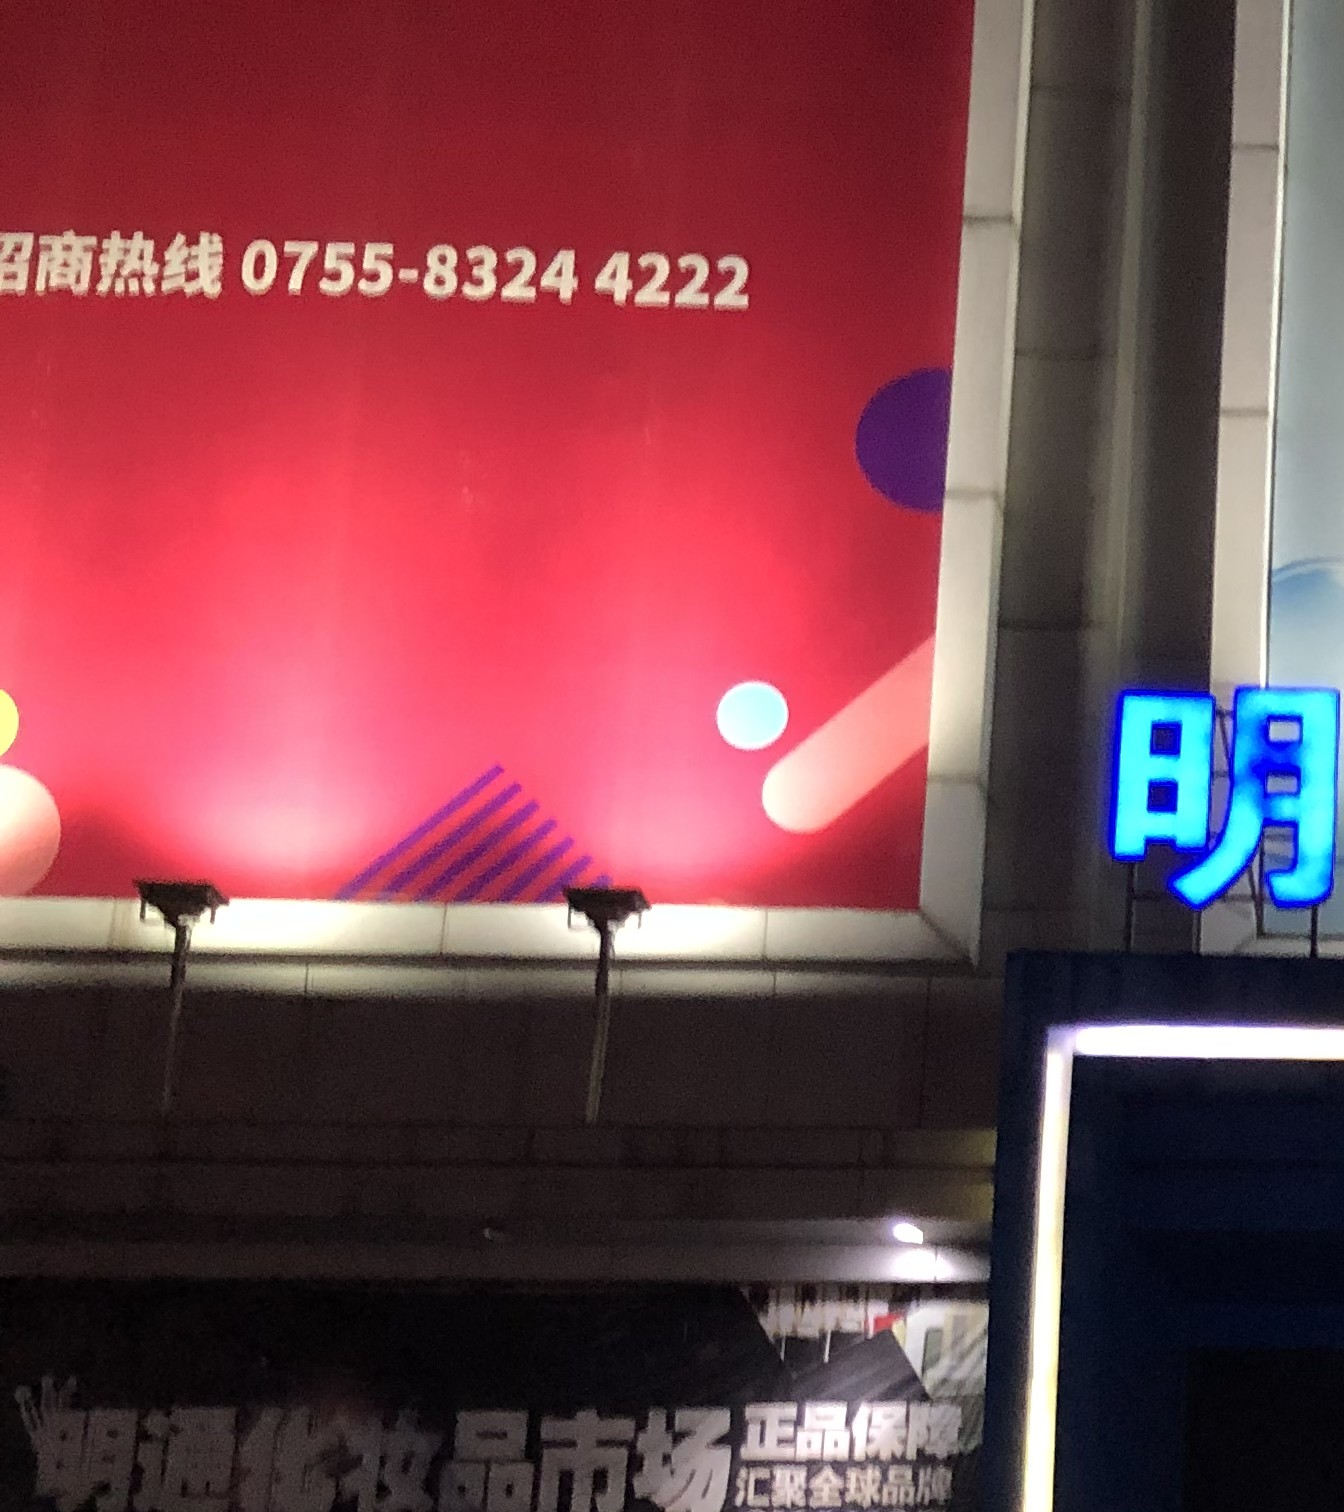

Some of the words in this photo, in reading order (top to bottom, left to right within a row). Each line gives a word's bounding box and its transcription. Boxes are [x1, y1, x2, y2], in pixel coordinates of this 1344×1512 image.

[241, 241, 578, 304] 0755-8324
[594, 251, 749, 311] 4222
[735, 1464, 953, 1508] 汇聚全球品牌
